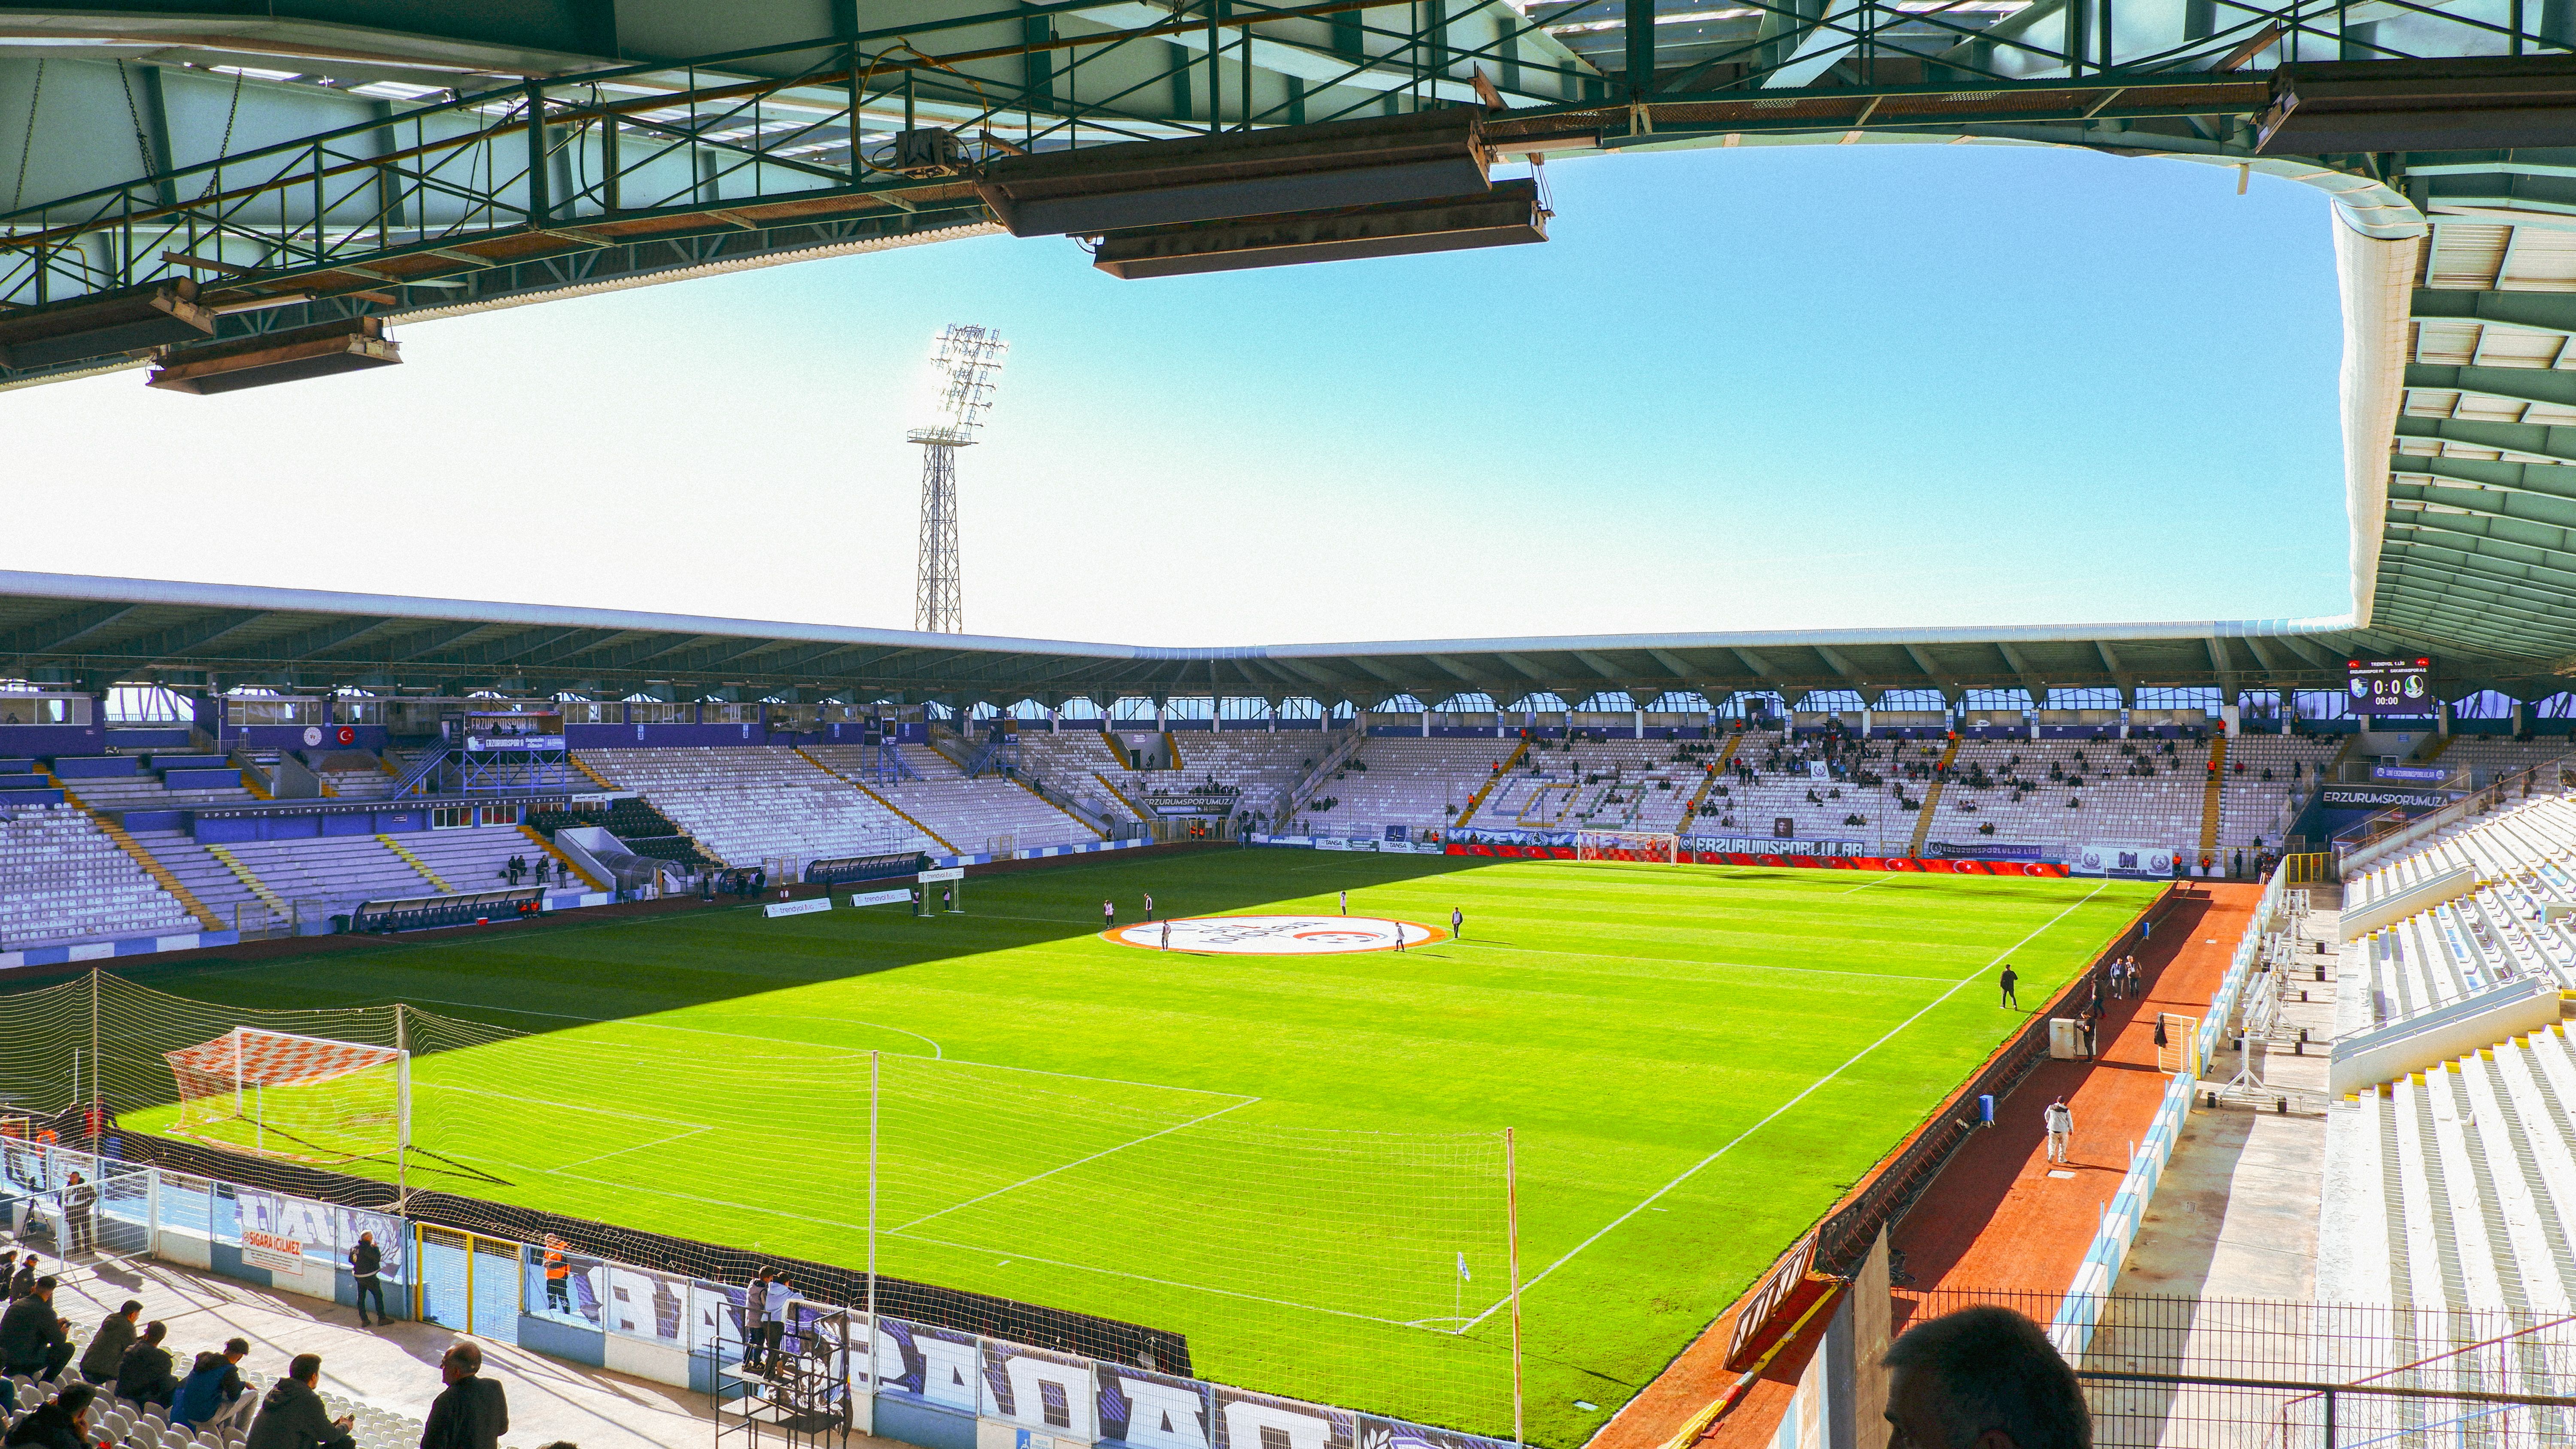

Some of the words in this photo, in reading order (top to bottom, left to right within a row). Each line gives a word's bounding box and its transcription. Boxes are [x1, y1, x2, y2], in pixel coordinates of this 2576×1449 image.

[2375, 697, 2399, 705] 00:00
[2323, 792, 2448, 807] ERZURUMSPOR'UMUZA
[279, 806, 355, 815] OLİMPİYAT
[865, 894, 886, 902] trendyol
[780, 904, 804, 914] trendyol
